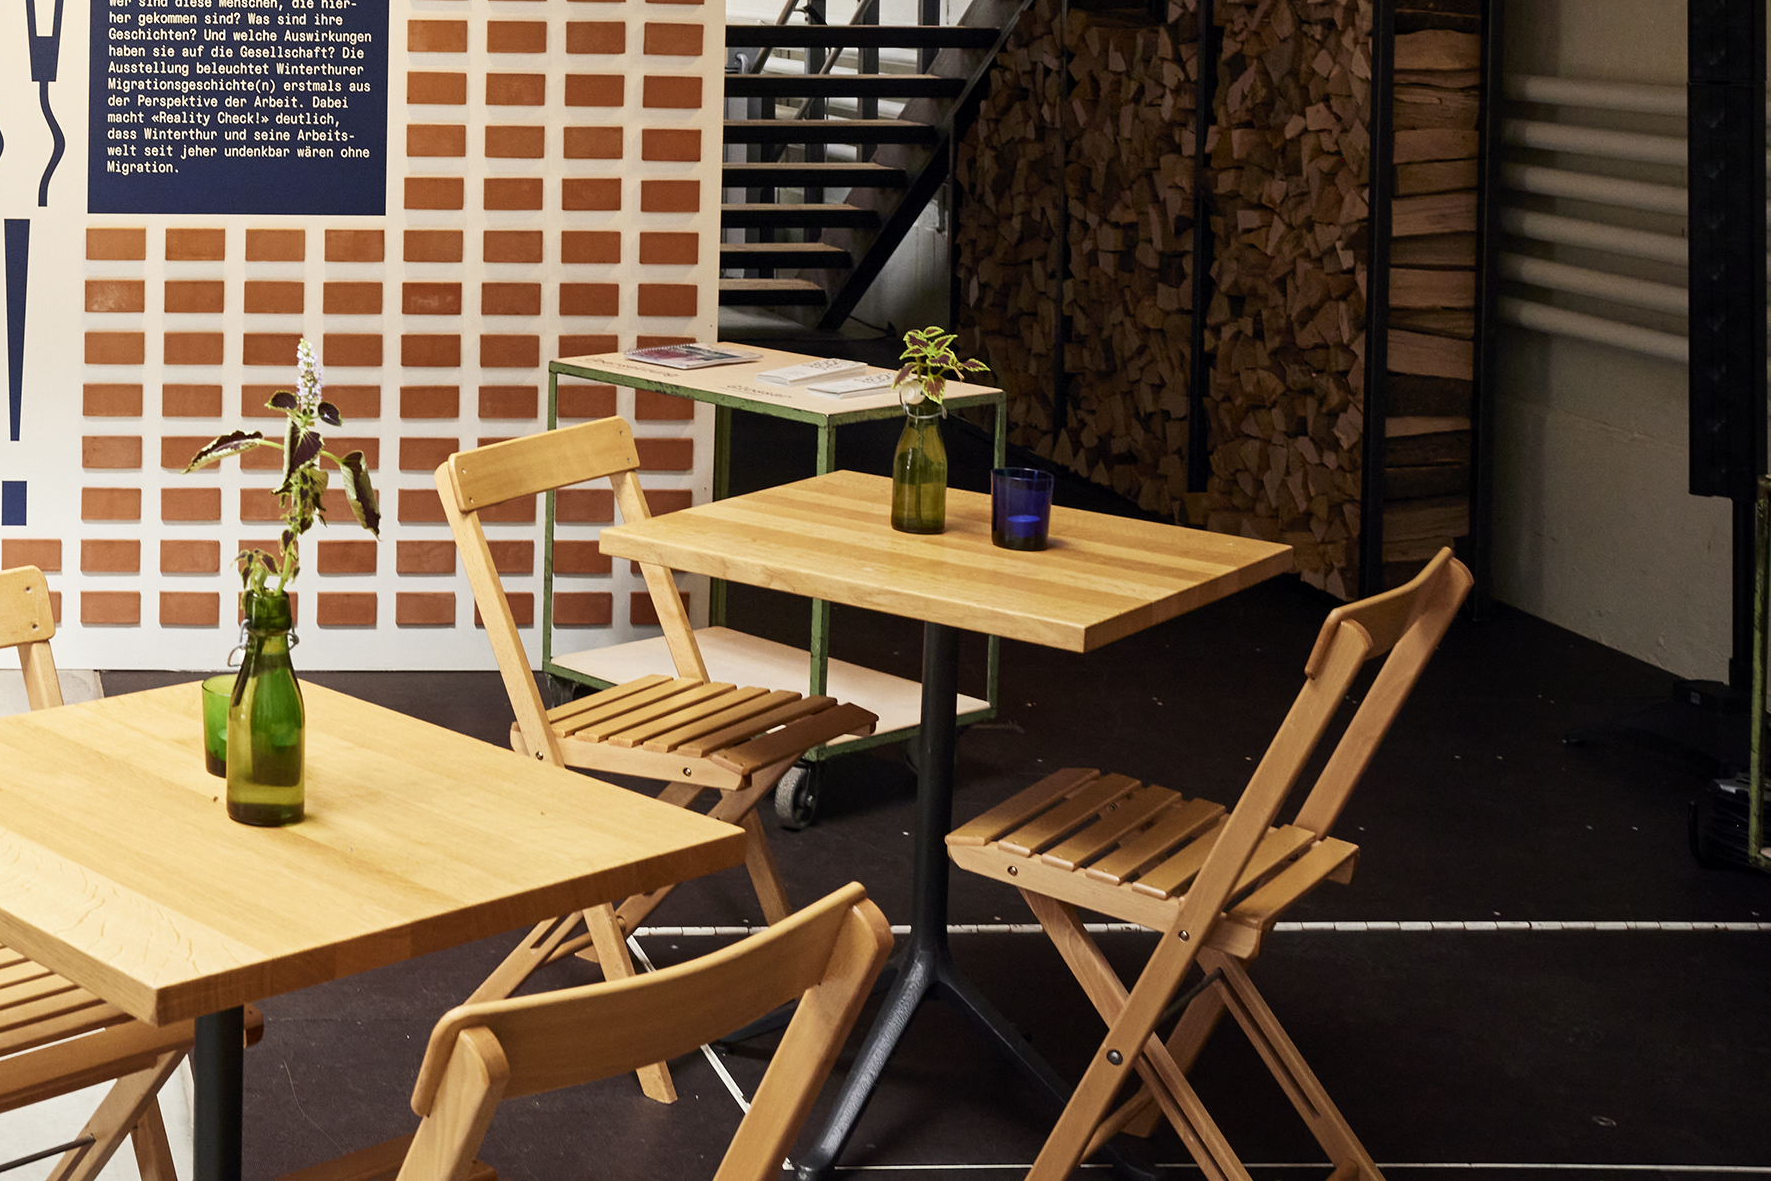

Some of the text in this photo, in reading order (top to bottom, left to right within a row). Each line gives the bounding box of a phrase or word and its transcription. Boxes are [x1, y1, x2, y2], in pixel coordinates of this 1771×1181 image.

[109, 11, 343, 27] her gekommen sind? Was sind ihre
[108, 27, 372, 45] Geschichten? Und welche Auswirkungen
[109, 44, 364, 59] haben sie auf die Gesellschaft? Die
[108, 61, 364, 77] Ausstellung beleuchtet Winterthurer
[108, 77, 371, 94] Migrationsgeschichte(n) erstmals aus
[108, 94, 348, 109] der Perspektive der Arbeit. Dabei
[107, 111, 339, 128] macht «Reality Check!» deutlich,
[107, 127, 355, 142] dass Winterthur und seine Arbeits-
[107, 144, 370, 160] welt seit jeher undenkbar wären ohne
[107, 160, 179, 176] Migration.
